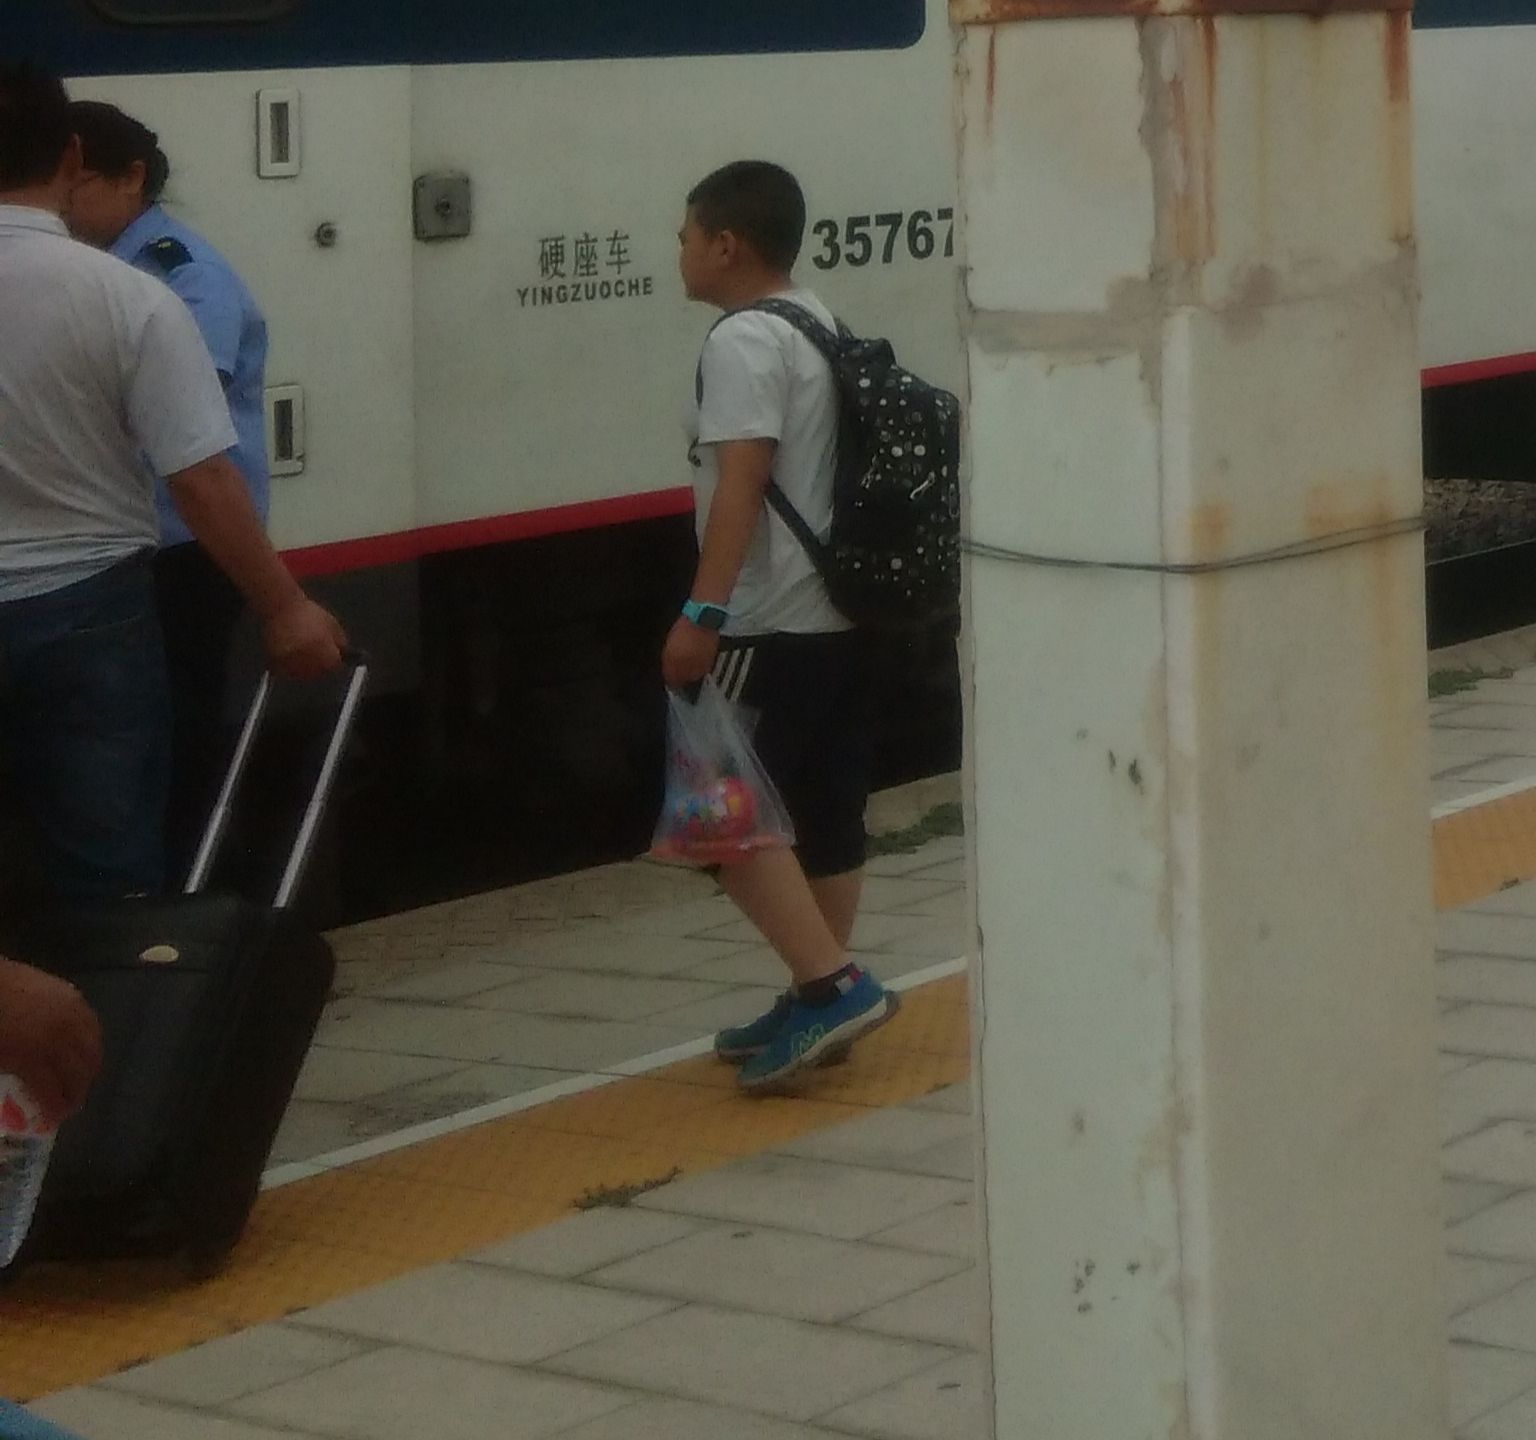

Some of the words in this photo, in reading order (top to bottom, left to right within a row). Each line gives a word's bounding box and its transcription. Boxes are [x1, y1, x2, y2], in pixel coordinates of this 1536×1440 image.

[538, 230, 632, 281] 硬座车
[517, 276, 654, 308] YINGZUOCHE
